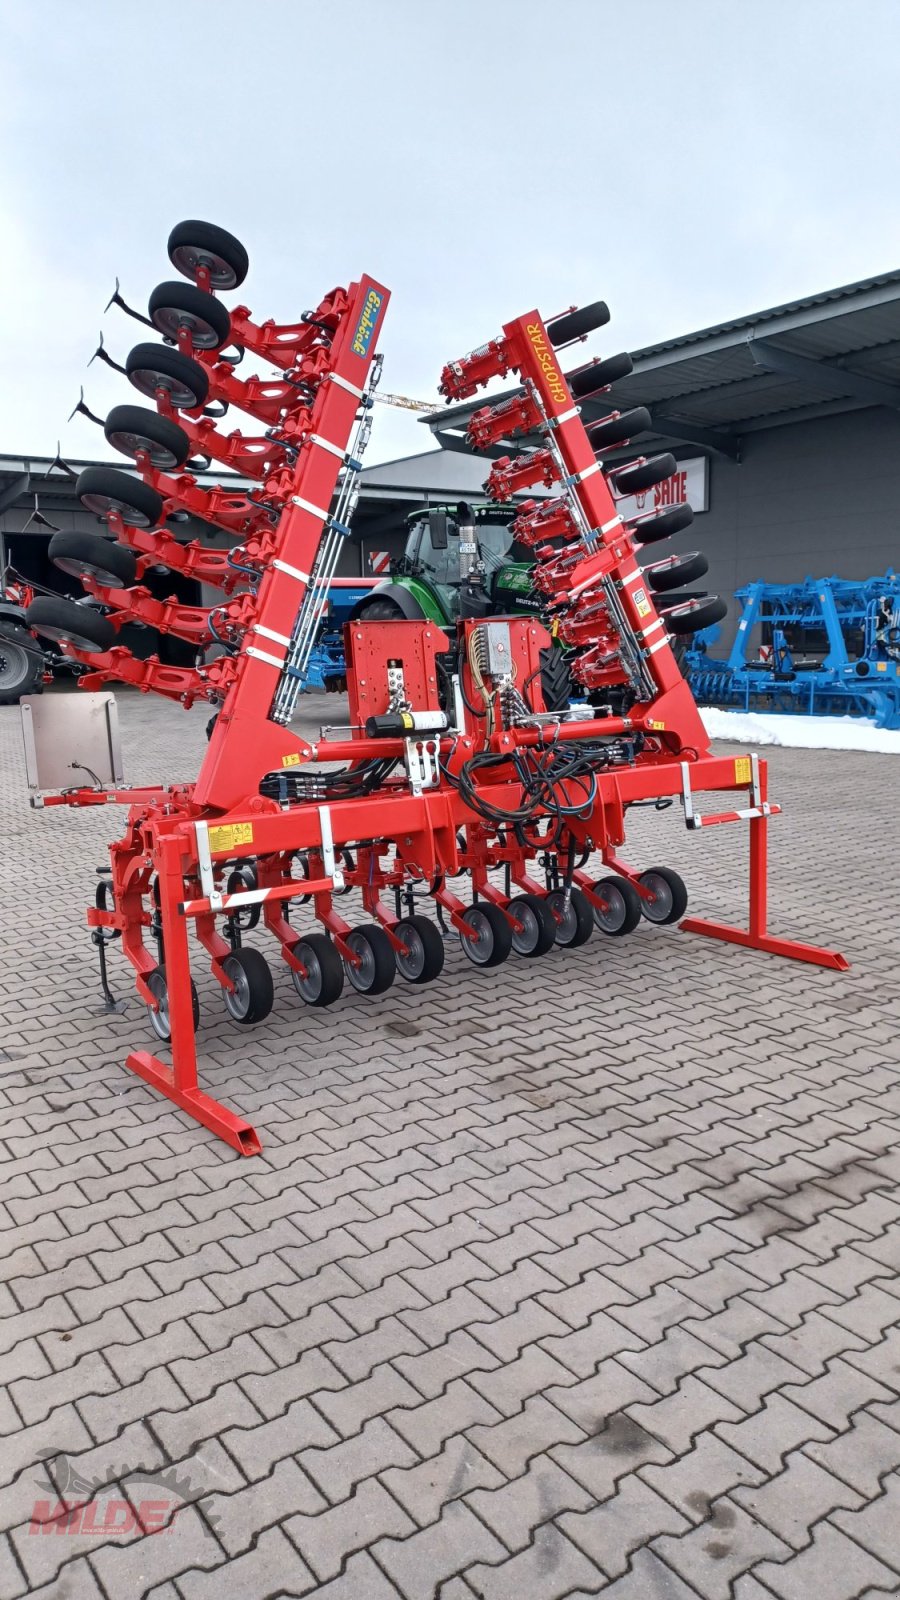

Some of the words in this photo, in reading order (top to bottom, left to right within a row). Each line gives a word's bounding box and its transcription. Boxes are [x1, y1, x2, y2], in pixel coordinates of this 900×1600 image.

[353, 291, 380, 355] Einböck
[527, 323, 567, 403] CHOPSTAR
[654, 471, 687, 506] SAME
